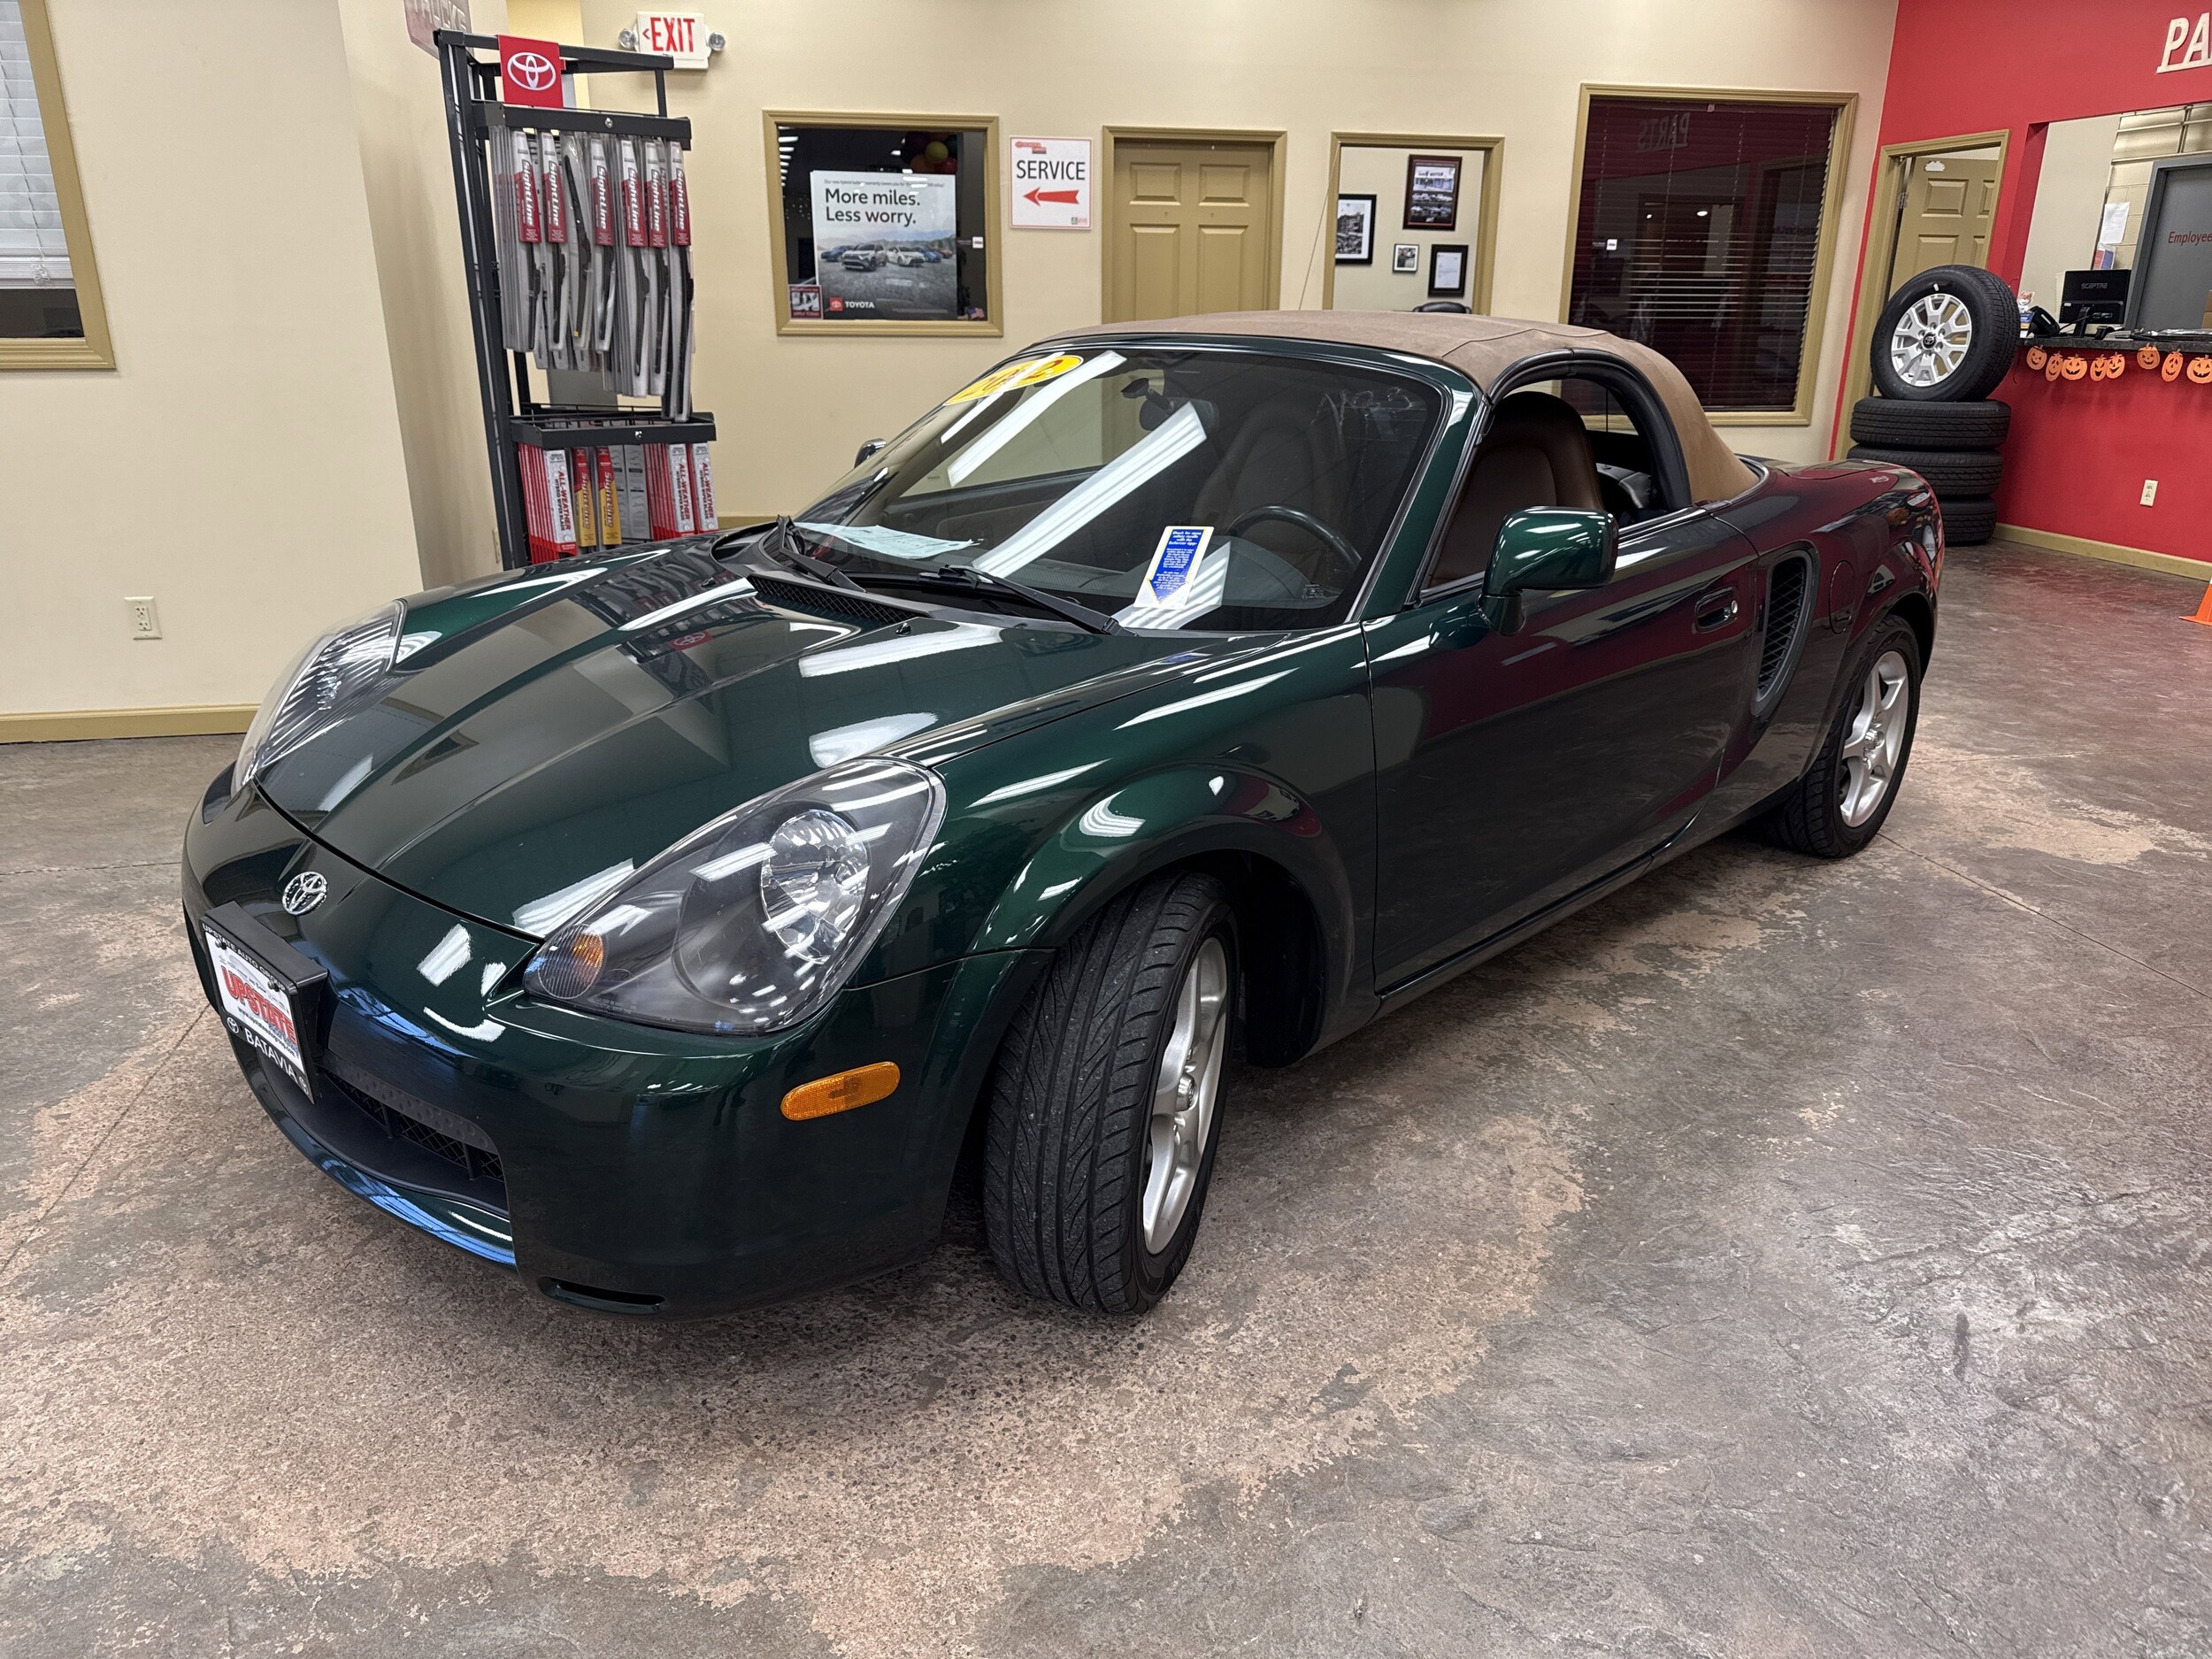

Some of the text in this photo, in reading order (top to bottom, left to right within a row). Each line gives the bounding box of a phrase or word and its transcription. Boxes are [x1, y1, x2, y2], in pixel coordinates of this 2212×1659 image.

[650, 16, 695, 52] EXIT
[2156, 12, 2212, 73] PA
[522, 161, 534, 227] SightLine
[549, 161, 560, 227] SightLine
[597, 166, 607, 230] SightLine
[628, 168, 639, 231] SightLine
[825, 188, 920, 206] More miles.
[1016, 160, 1086, 180] SERVICE
[651, 169, 660, 232] SightLine
[676, 169, 686, 232] SightLine
[826, 206, 916, 227] Less worry.
[2168, 230, 2212, 246] Employee
[558, 470, 572, 530] ALL-WEATHER
[679, 463, 691, 520] ALL-WEATHER
[702, 462, 714, 518] ALL-WEATHER
[202, 922, 237, 952] UPSTATE
[238, 949, 258, 969] AUTO
[259, 966, 286, 991] GROUP
[220, 965, 297, 1045] UPSTATE
[244, 1027, 299, 1084] BATAVIA
